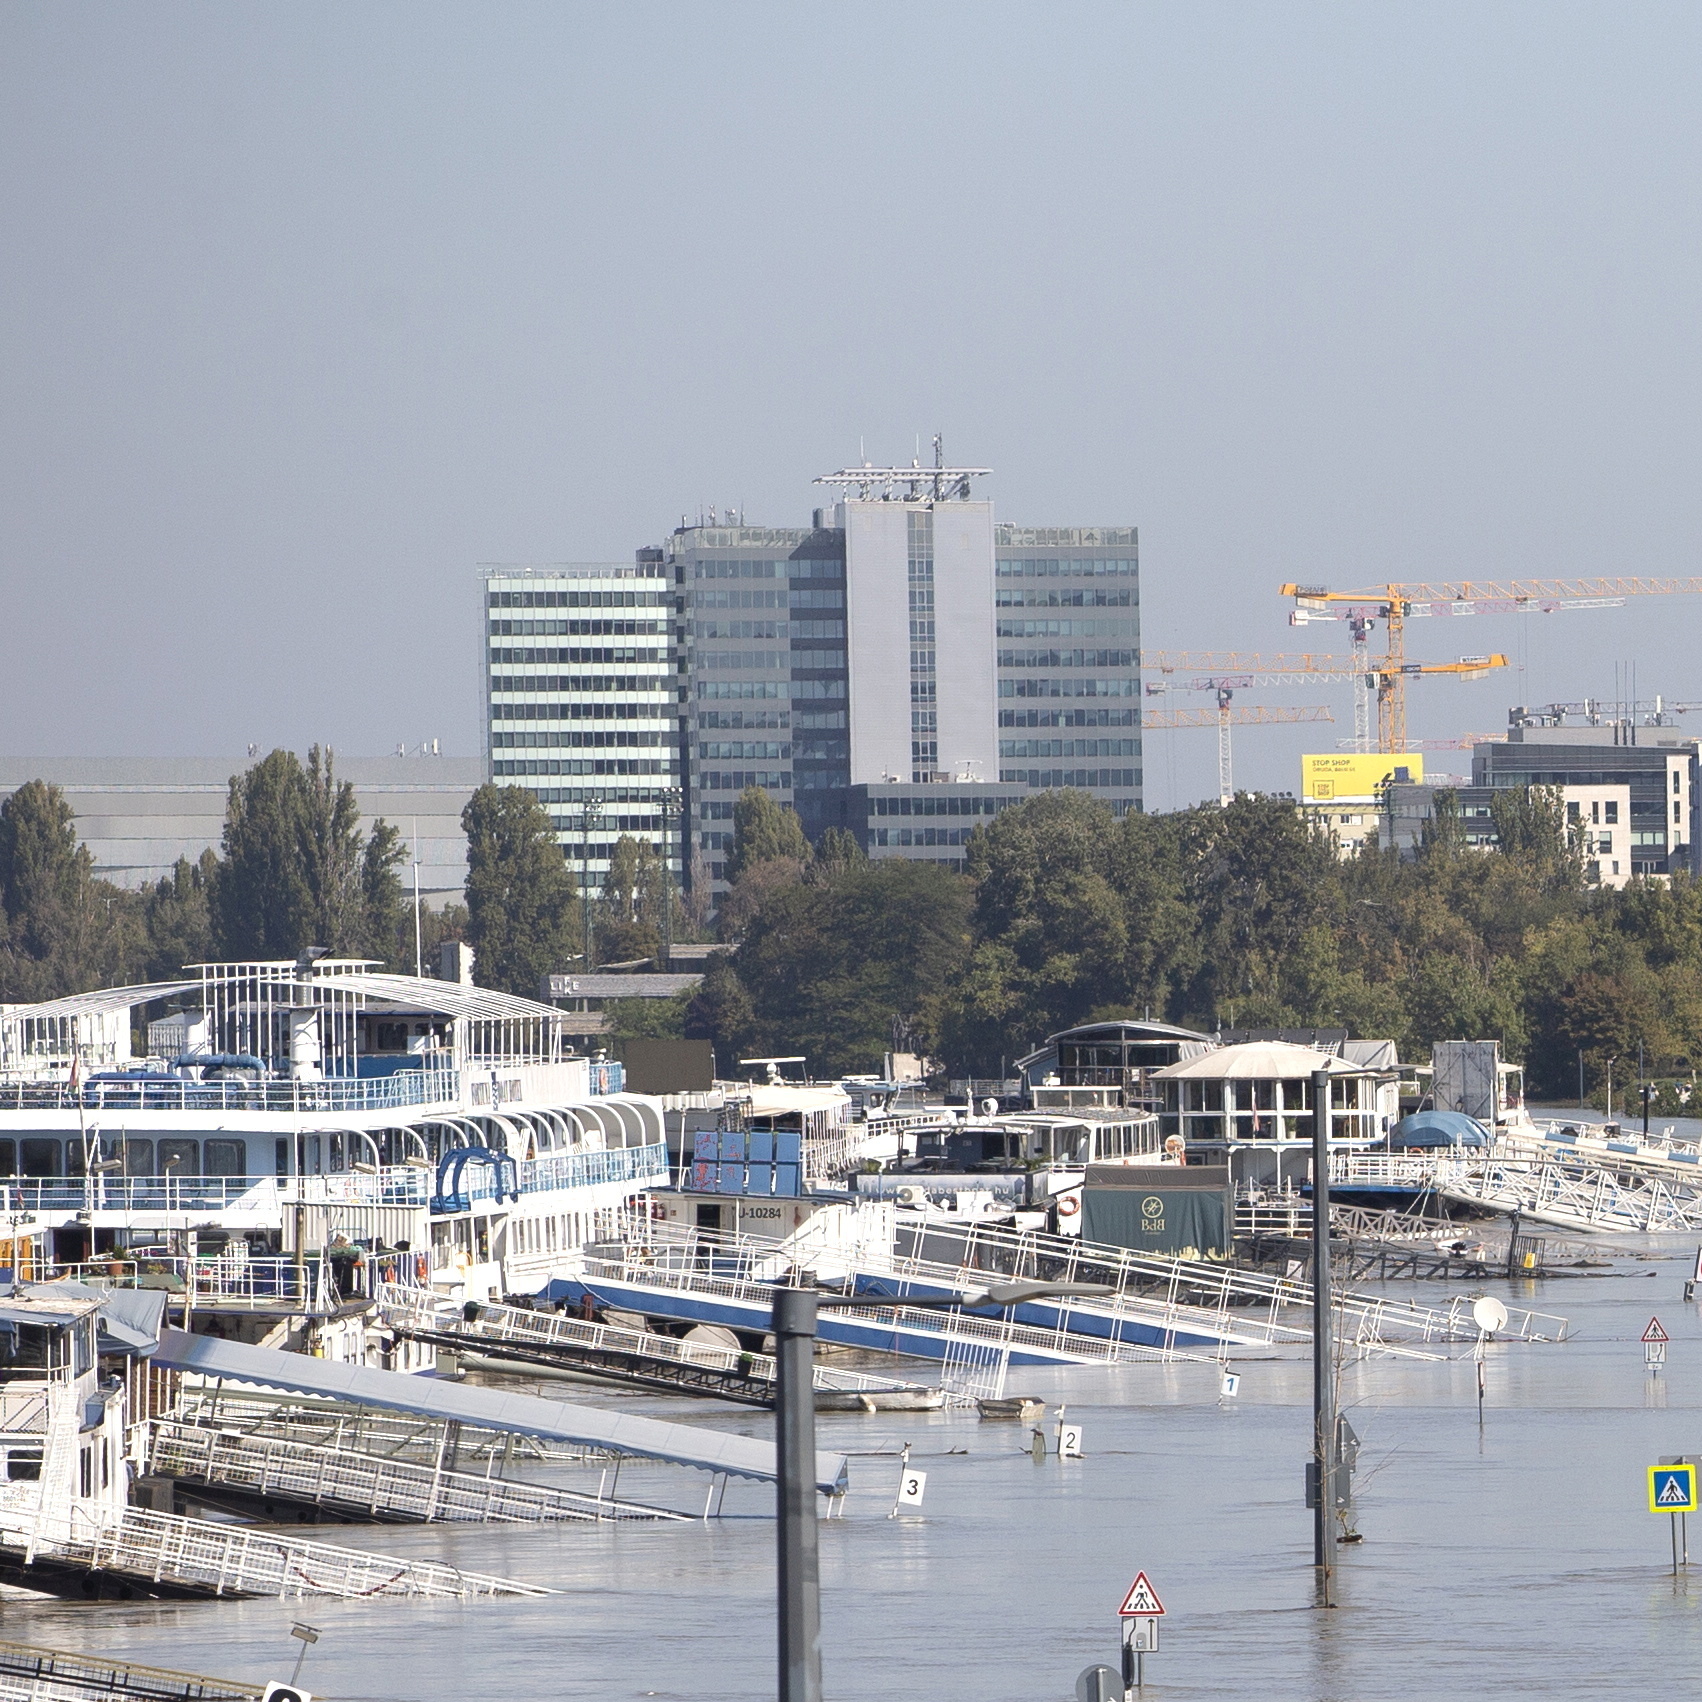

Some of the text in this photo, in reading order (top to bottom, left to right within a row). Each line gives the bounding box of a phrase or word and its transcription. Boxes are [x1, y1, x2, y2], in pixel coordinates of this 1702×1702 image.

[1226, 1377, 1235, 1391] 1
[1066, 1432, 1076, 1449] 2
[907, 1480, 919, 1495] 3
